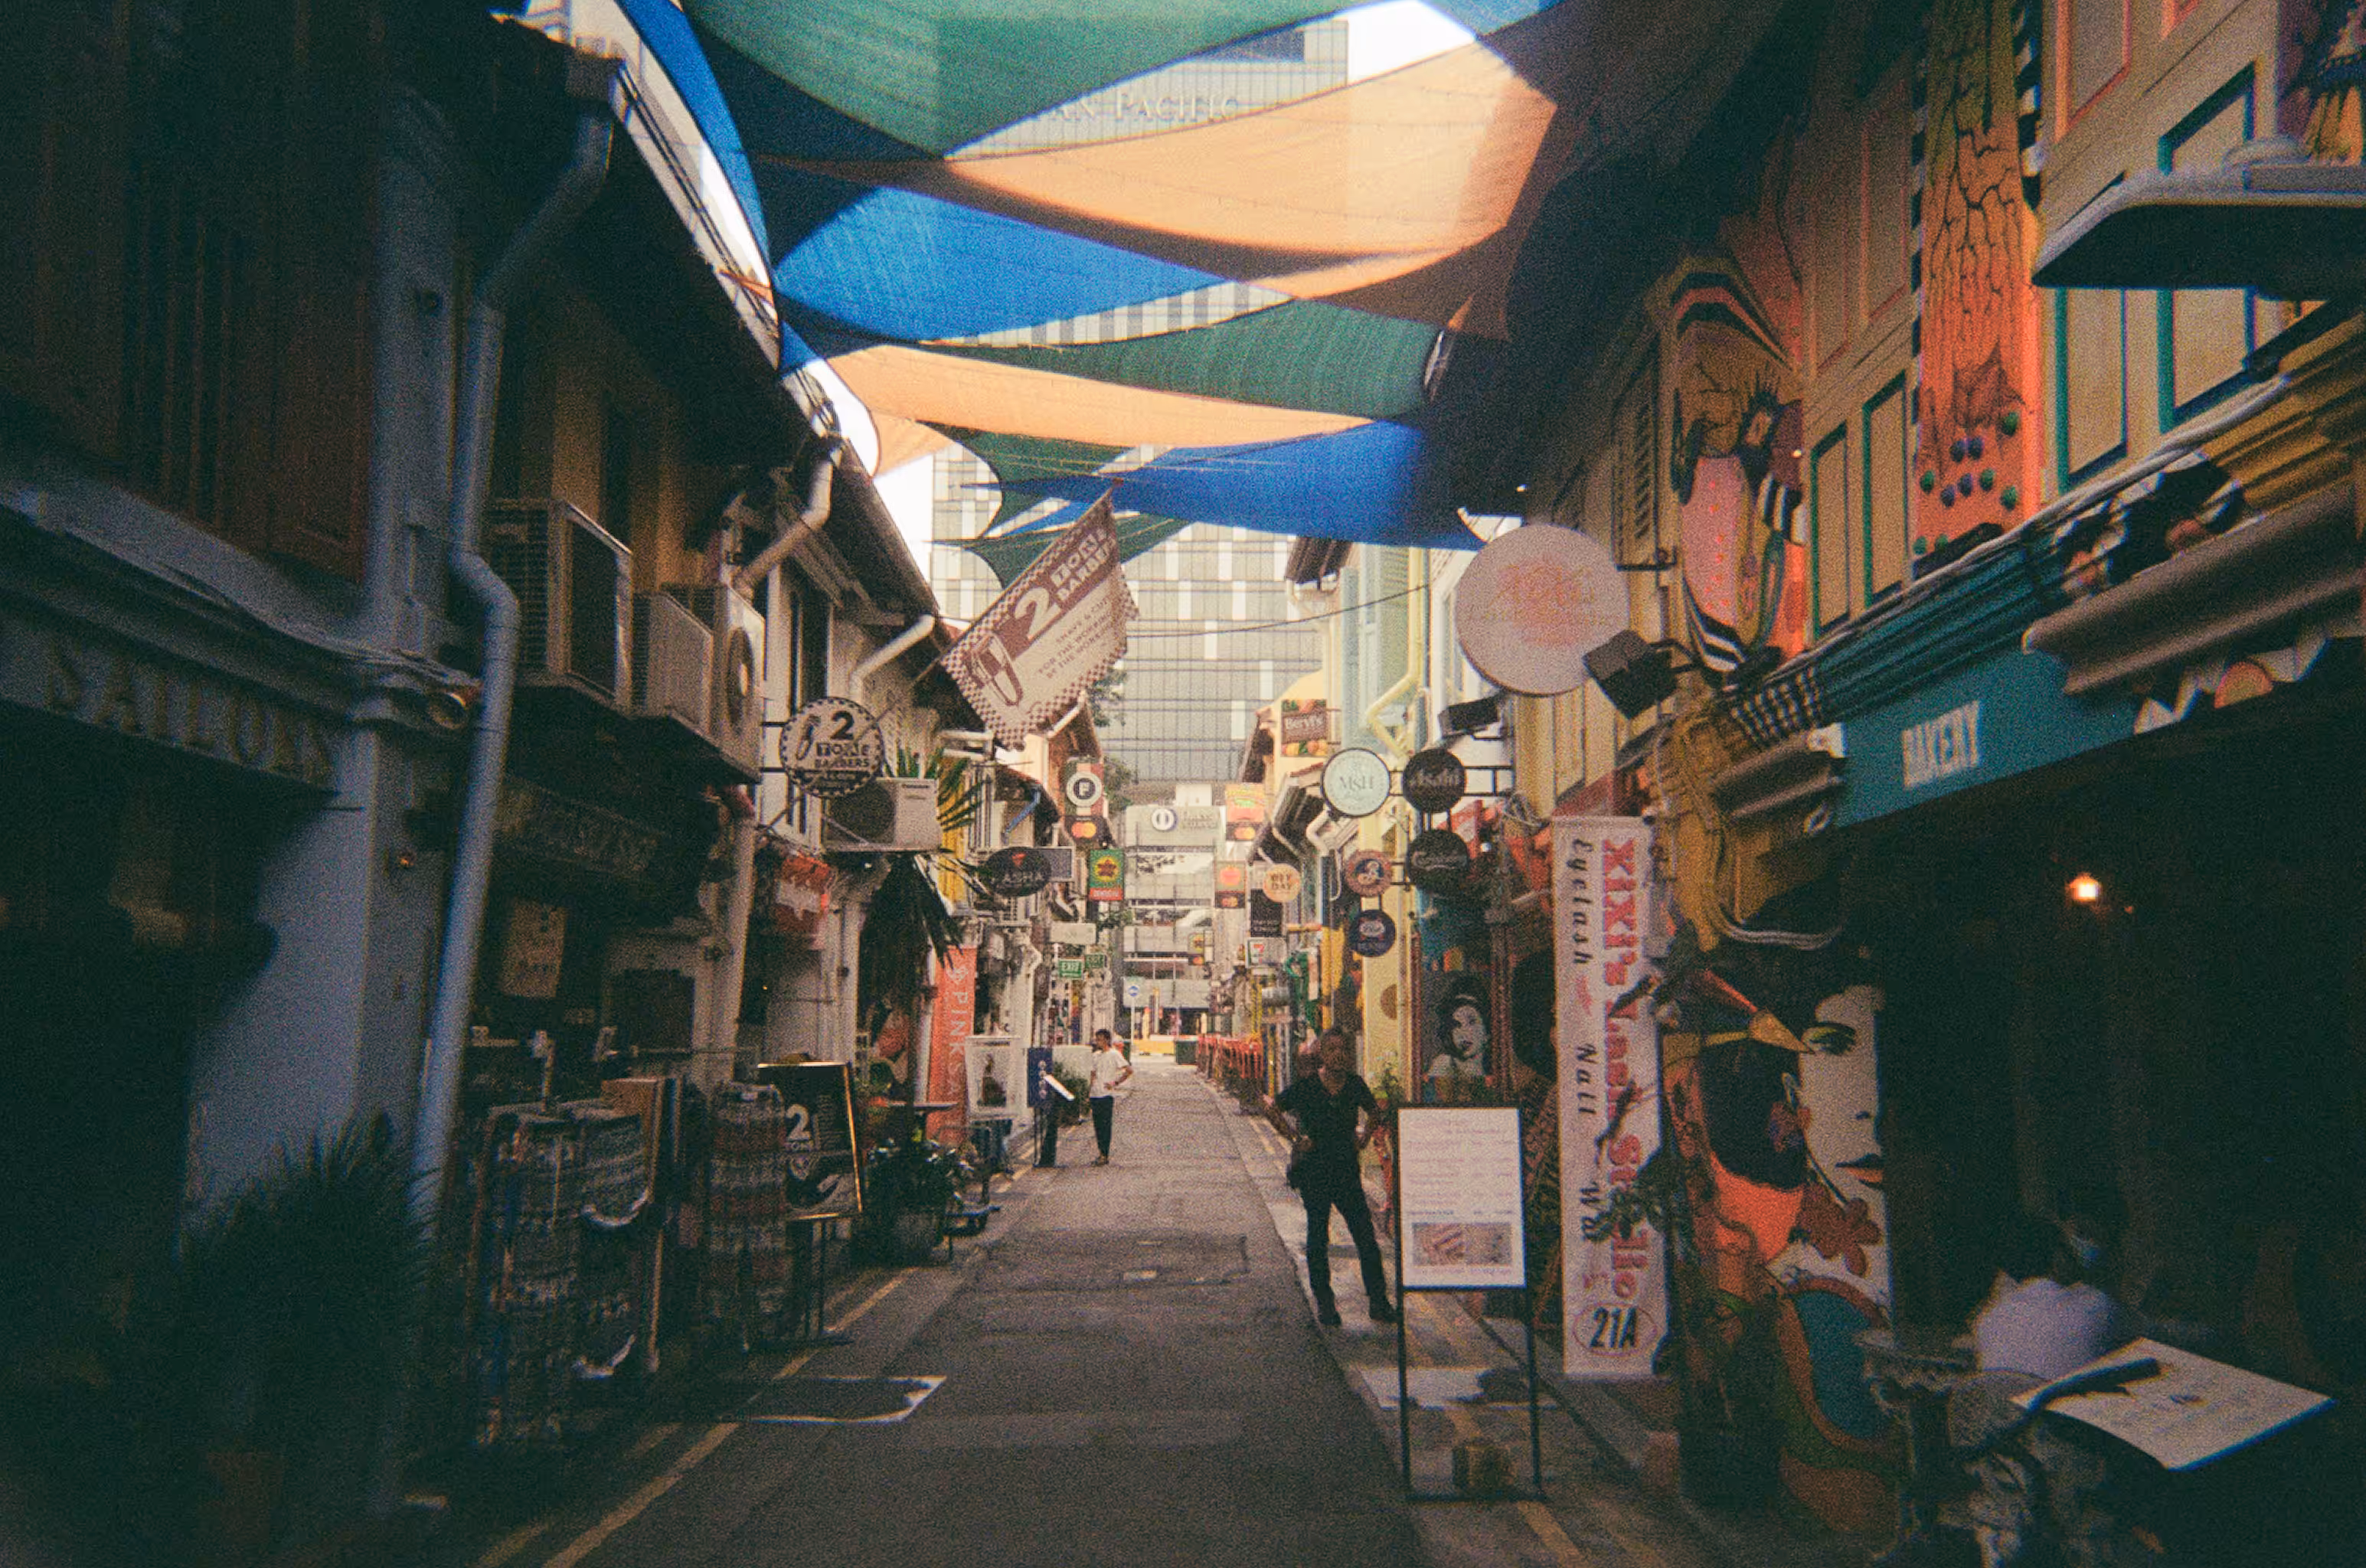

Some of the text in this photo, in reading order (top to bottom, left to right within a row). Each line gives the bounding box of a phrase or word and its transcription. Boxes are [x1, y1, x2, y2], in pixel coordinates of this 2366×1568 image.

[1051, 98, 1100, 122] AN
[1015, 586, 1061, 641] 2
[830, 710, 855, 740] 2
[1901, 700, 1982, 791] BAKERY
[1576, 1042, 1600, 1116] Nail
[785, 1103, 812, 1142] 2
[1608, 1133, 1649, 1299] Stdio
[1589, 1306, 1640, 1349] 21A
